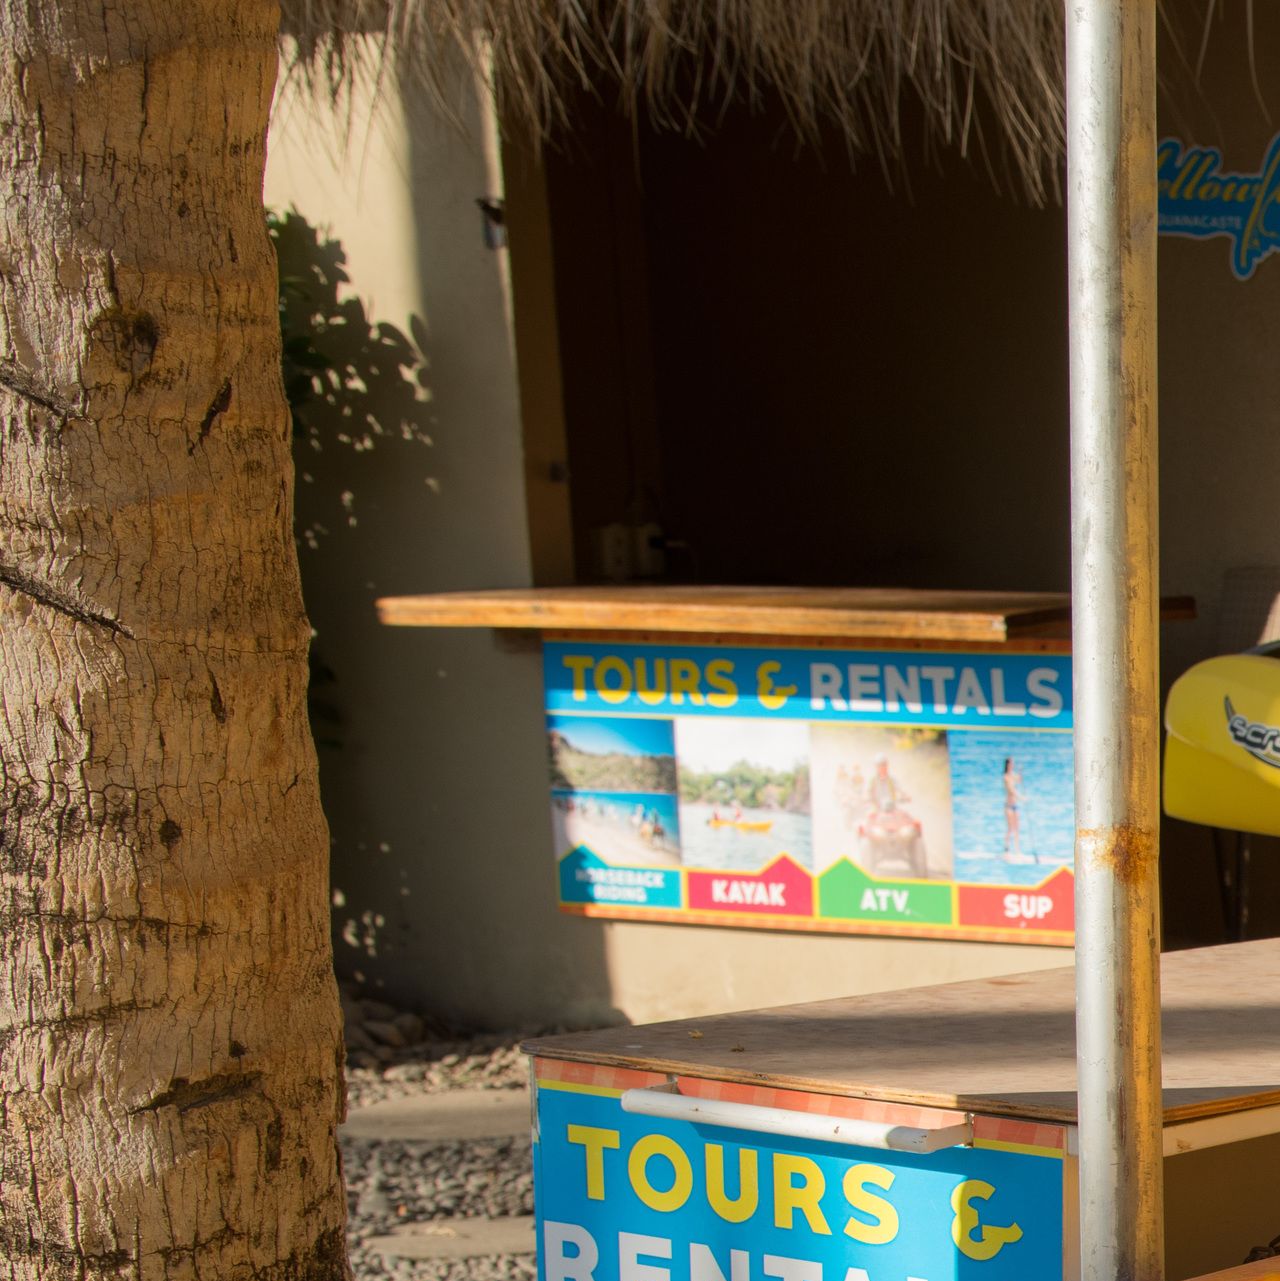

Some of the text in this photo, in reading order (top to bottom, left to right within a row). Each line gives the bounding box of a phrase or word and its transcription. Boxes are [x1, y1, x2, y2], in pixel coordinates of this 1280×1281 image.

[562, 654, 1064, 718] TOURS & RENTALS
[711, 878, 786, 907] KAYAK
[859, 889, 909, 913] ATV
[1003, 893, 1053, 919] SUP
[566, 1123, 1024, 1261] TOURS &
